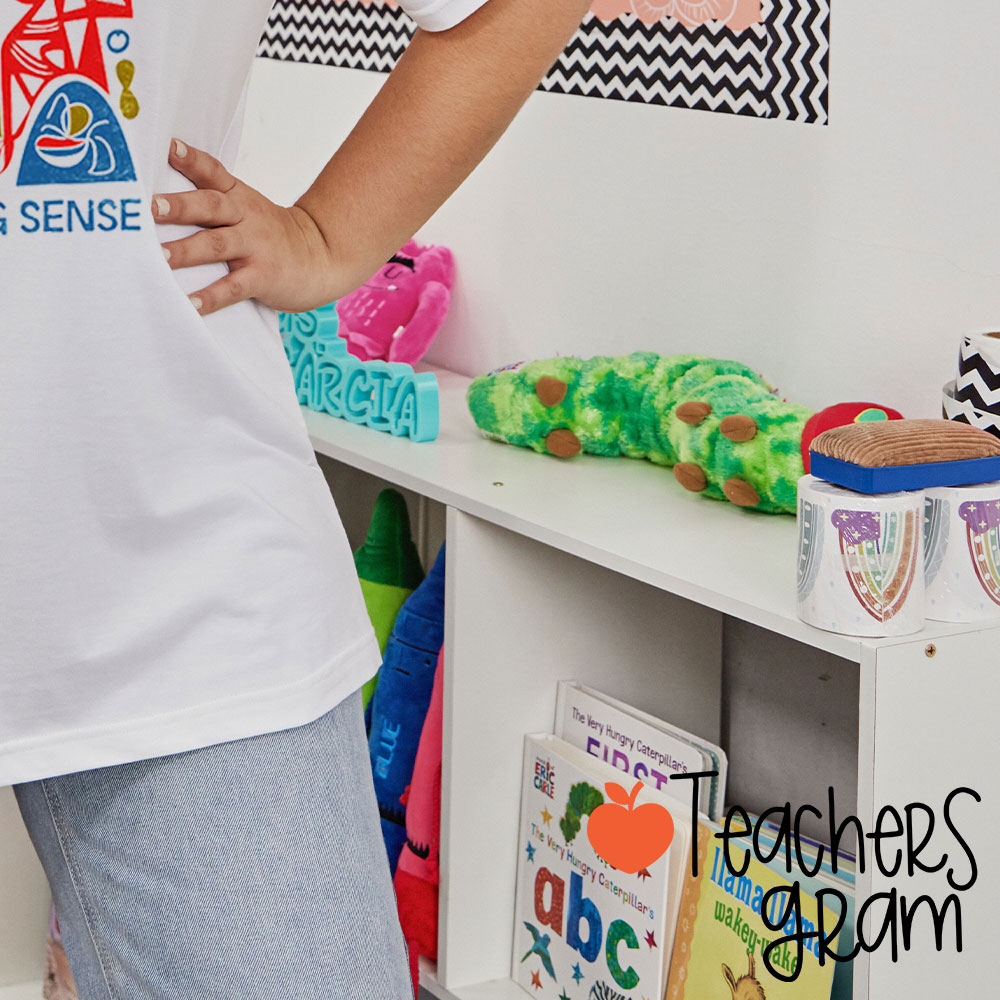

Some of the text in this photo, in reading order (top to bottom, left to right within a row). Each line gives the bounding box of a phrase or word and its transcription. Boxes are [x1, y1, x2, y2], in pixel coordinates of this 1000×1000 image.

[17, 198, 142, 233] SENSE
[375, 718, 401, 780] BLUE
[572, 706, 688, 774] The Very Hungry Caterpillar's
[534, 775, 555, 800] CARLE
[535, 761, 555, 786] ERIC
[531, 823, 655, 920] The Very Hungry Caterpillar's
[533, 866, 641, 991] abc
